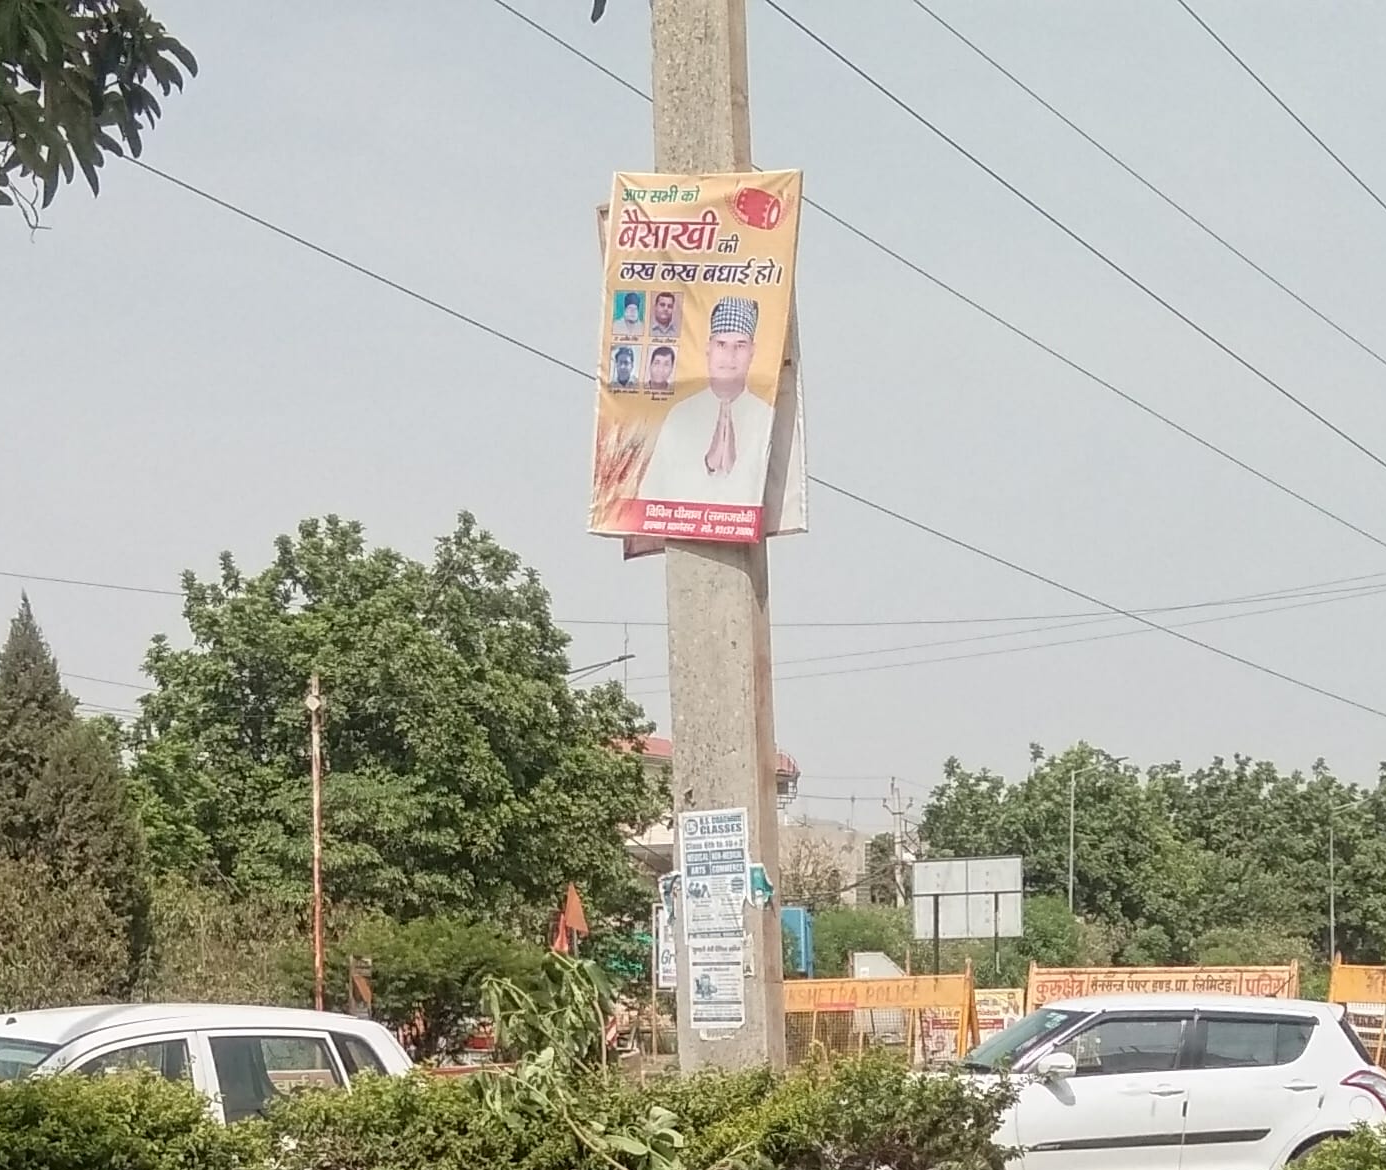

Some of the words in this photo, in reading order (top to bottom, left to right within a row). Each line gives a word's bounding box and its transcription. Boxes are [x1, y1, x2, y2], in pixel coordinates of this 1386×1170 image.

[622, 187, 645, 202] आप
[650, 185, 678, 203] सभी
[681, 185, 700, 202] को
[619, 209, 719, 250] बैसाखी
[718, 234, 739, 253] की
[620, 262, 657, 280] लख
[661, 263, 699, 281] लख
[703, 258, 756, 284] बधाई
[700, 823, 742, 835] CLASSES
[691, 866, 707, 875] ARTS
